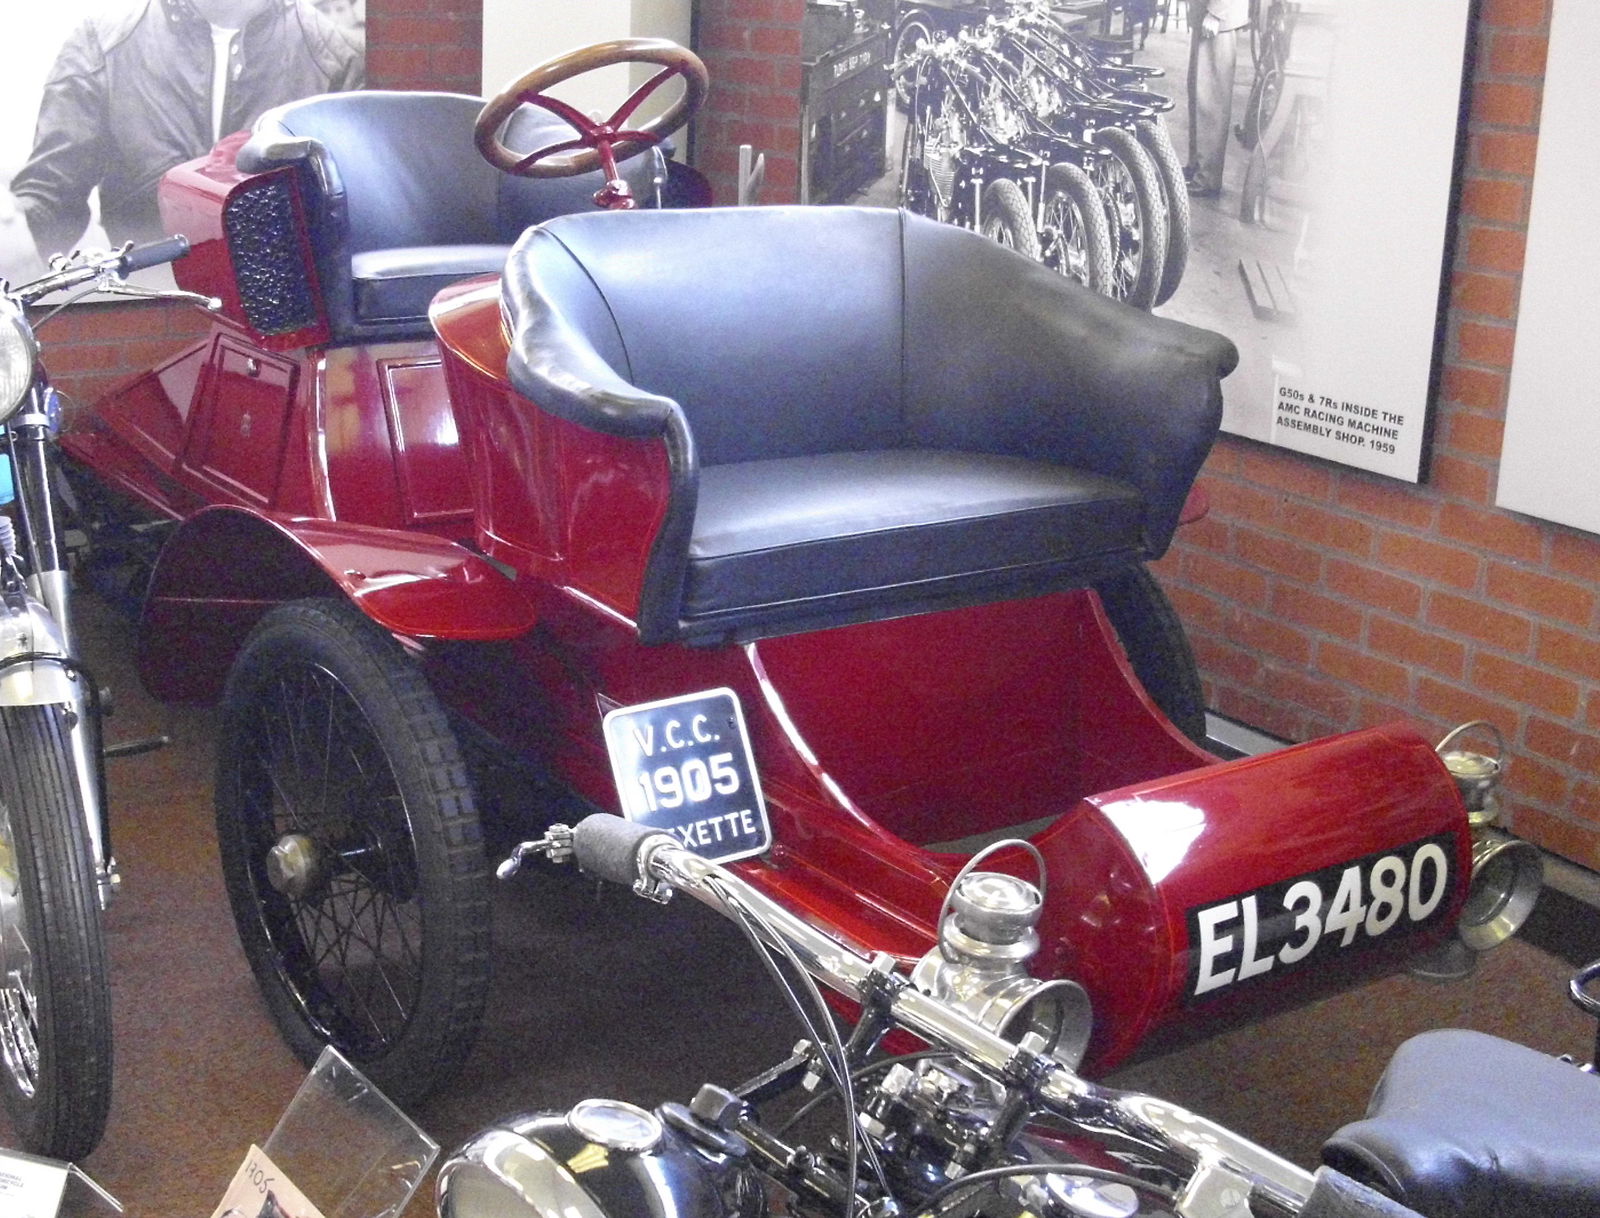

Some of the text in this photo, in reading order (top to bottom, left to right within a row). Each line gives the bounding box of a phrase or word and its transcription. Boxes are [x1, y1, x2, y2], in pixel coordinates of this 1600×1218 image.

[1278, 401, 1398, 440] AMC RACING MACHINE
[1279, 387, 1404, 426] G50s & 7Rs INSIDE THE
[1276, 416, 1332, 438] ASSEMBLY
[1370, 440, 1395, 455] 1959
[632, 713, 721, 757] V.C.C.
[637, 752, 740, 812] 1905
[670, 809, 757, 848] XETTE
